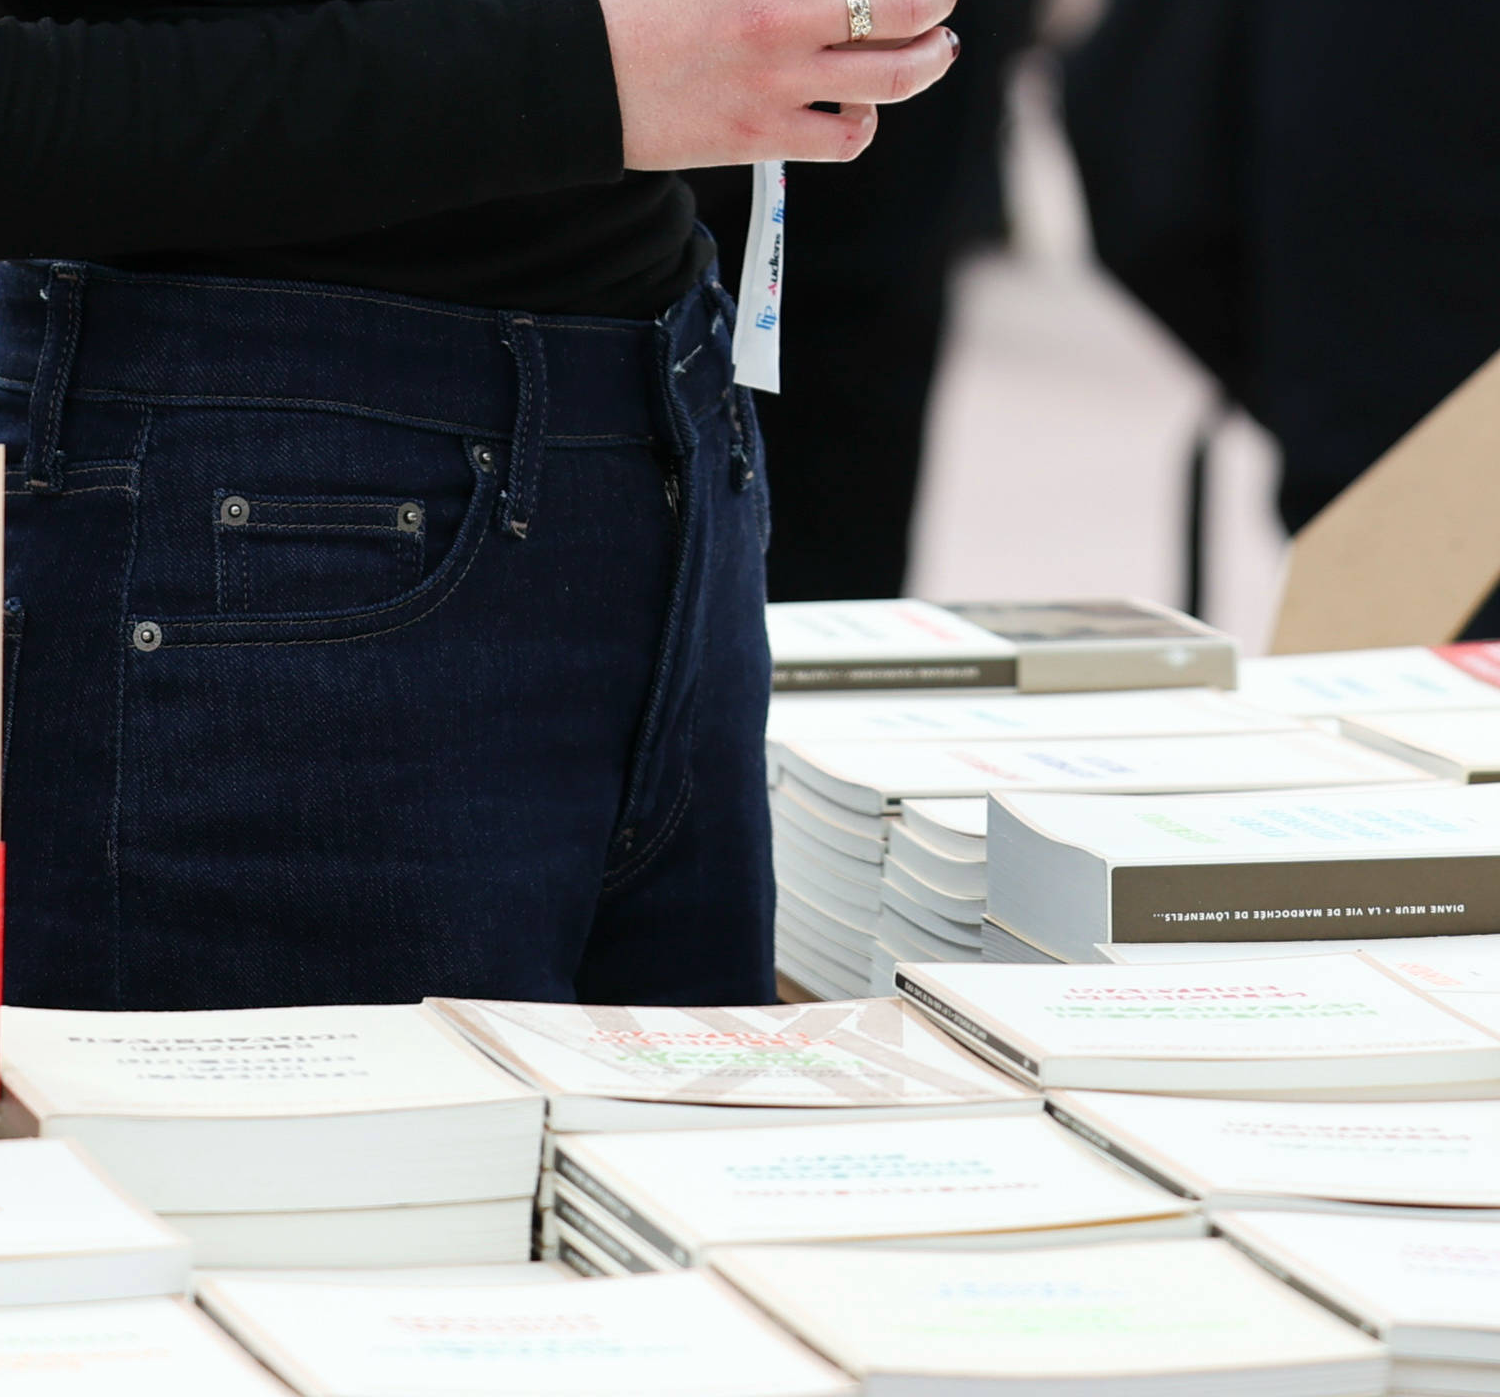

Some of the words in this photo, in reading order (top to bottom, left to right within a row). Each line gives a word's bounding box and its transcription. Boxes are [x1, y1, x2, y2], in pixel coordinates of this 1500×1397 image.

[1252, 908, 1322, 920] MARDOCHÉE
[1325, 908, 1341, 918] DE
[1344, 907, 1364, 917] VIE
[1366, 906, 1381, 916] LA
[1394, 905, 1427, 915] MEUR
[1429, 904, 1465, 914] DIANE
[1233, 910, 1249, 920] DE
